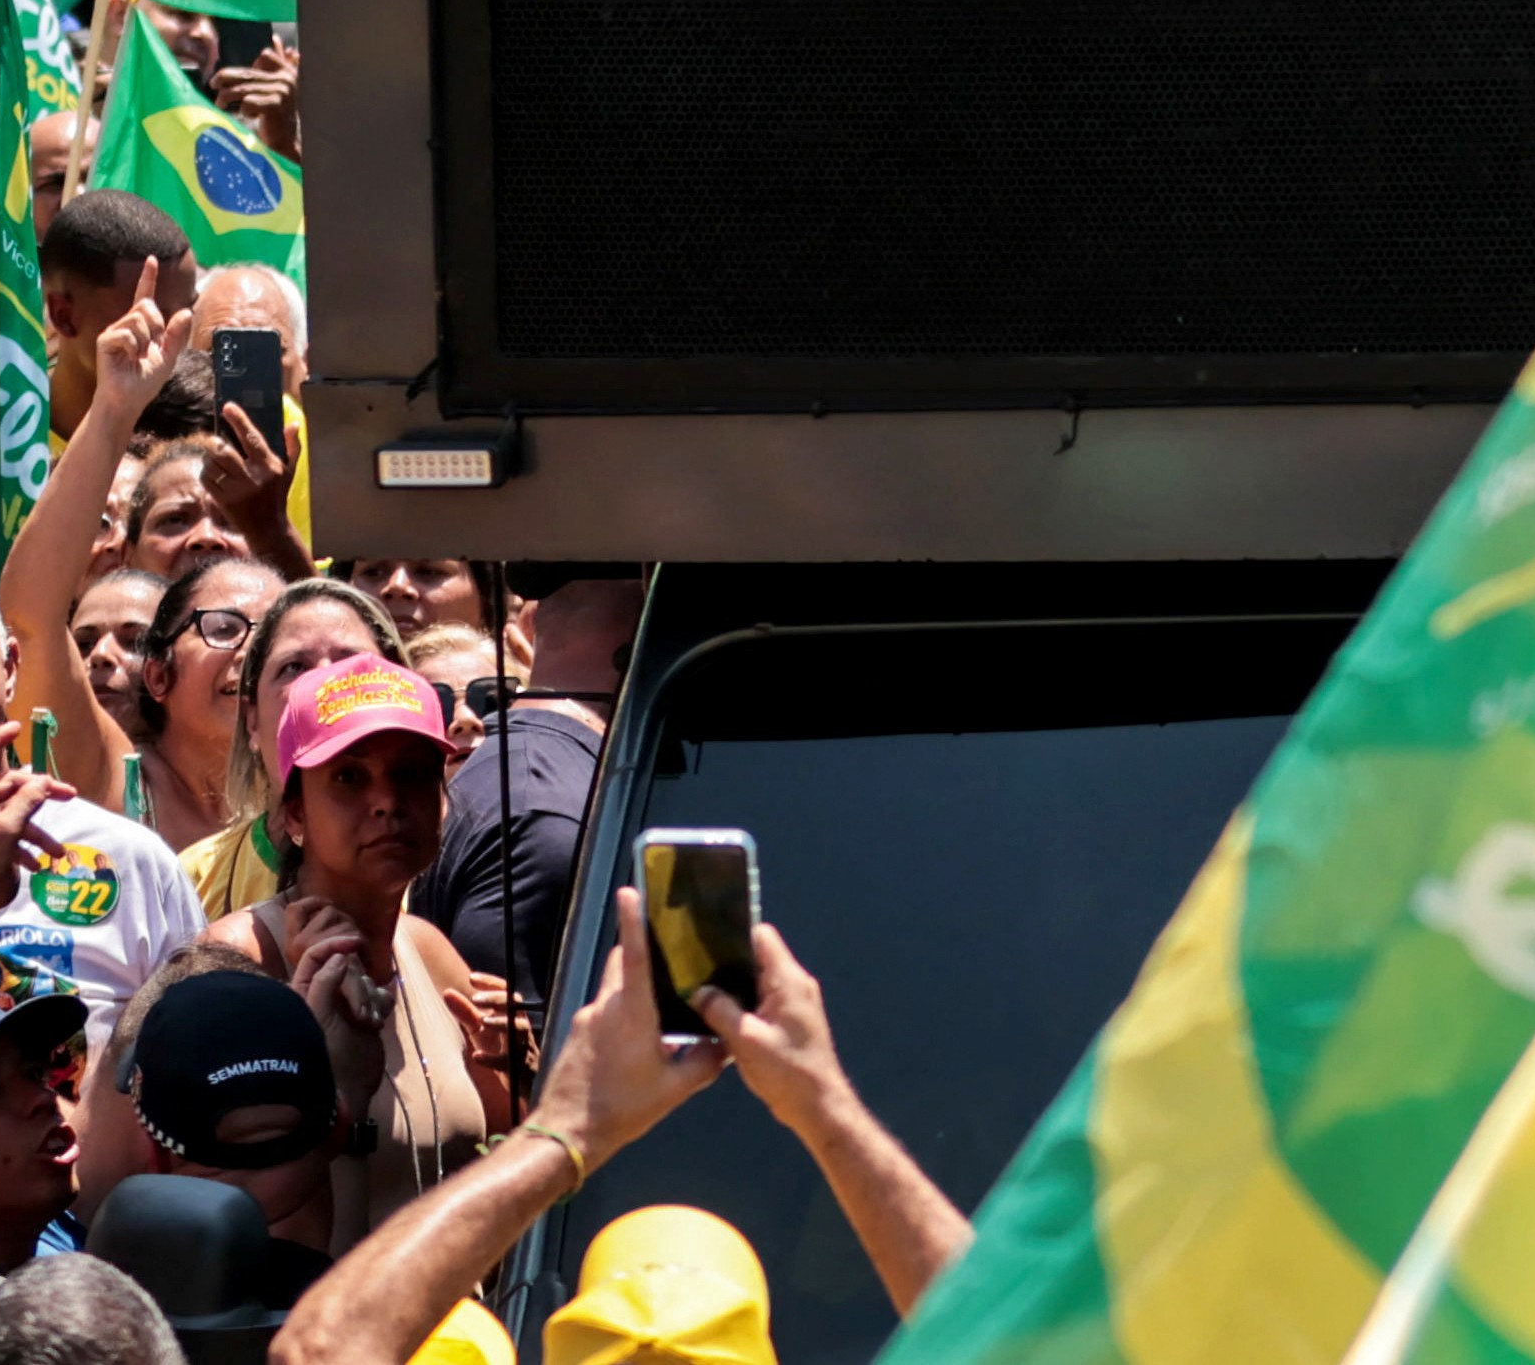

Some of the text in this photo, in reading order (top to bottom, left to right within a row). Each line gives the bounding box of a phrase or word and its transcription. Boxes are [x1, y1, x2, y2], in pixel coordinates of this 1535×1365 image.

[1, 230, 35, 279] Vice
[317, 687, 388, 724] Douglas
[69, 879, 112, 918] 22
[206, 1058, 299, 1085] SEMMATRAN
